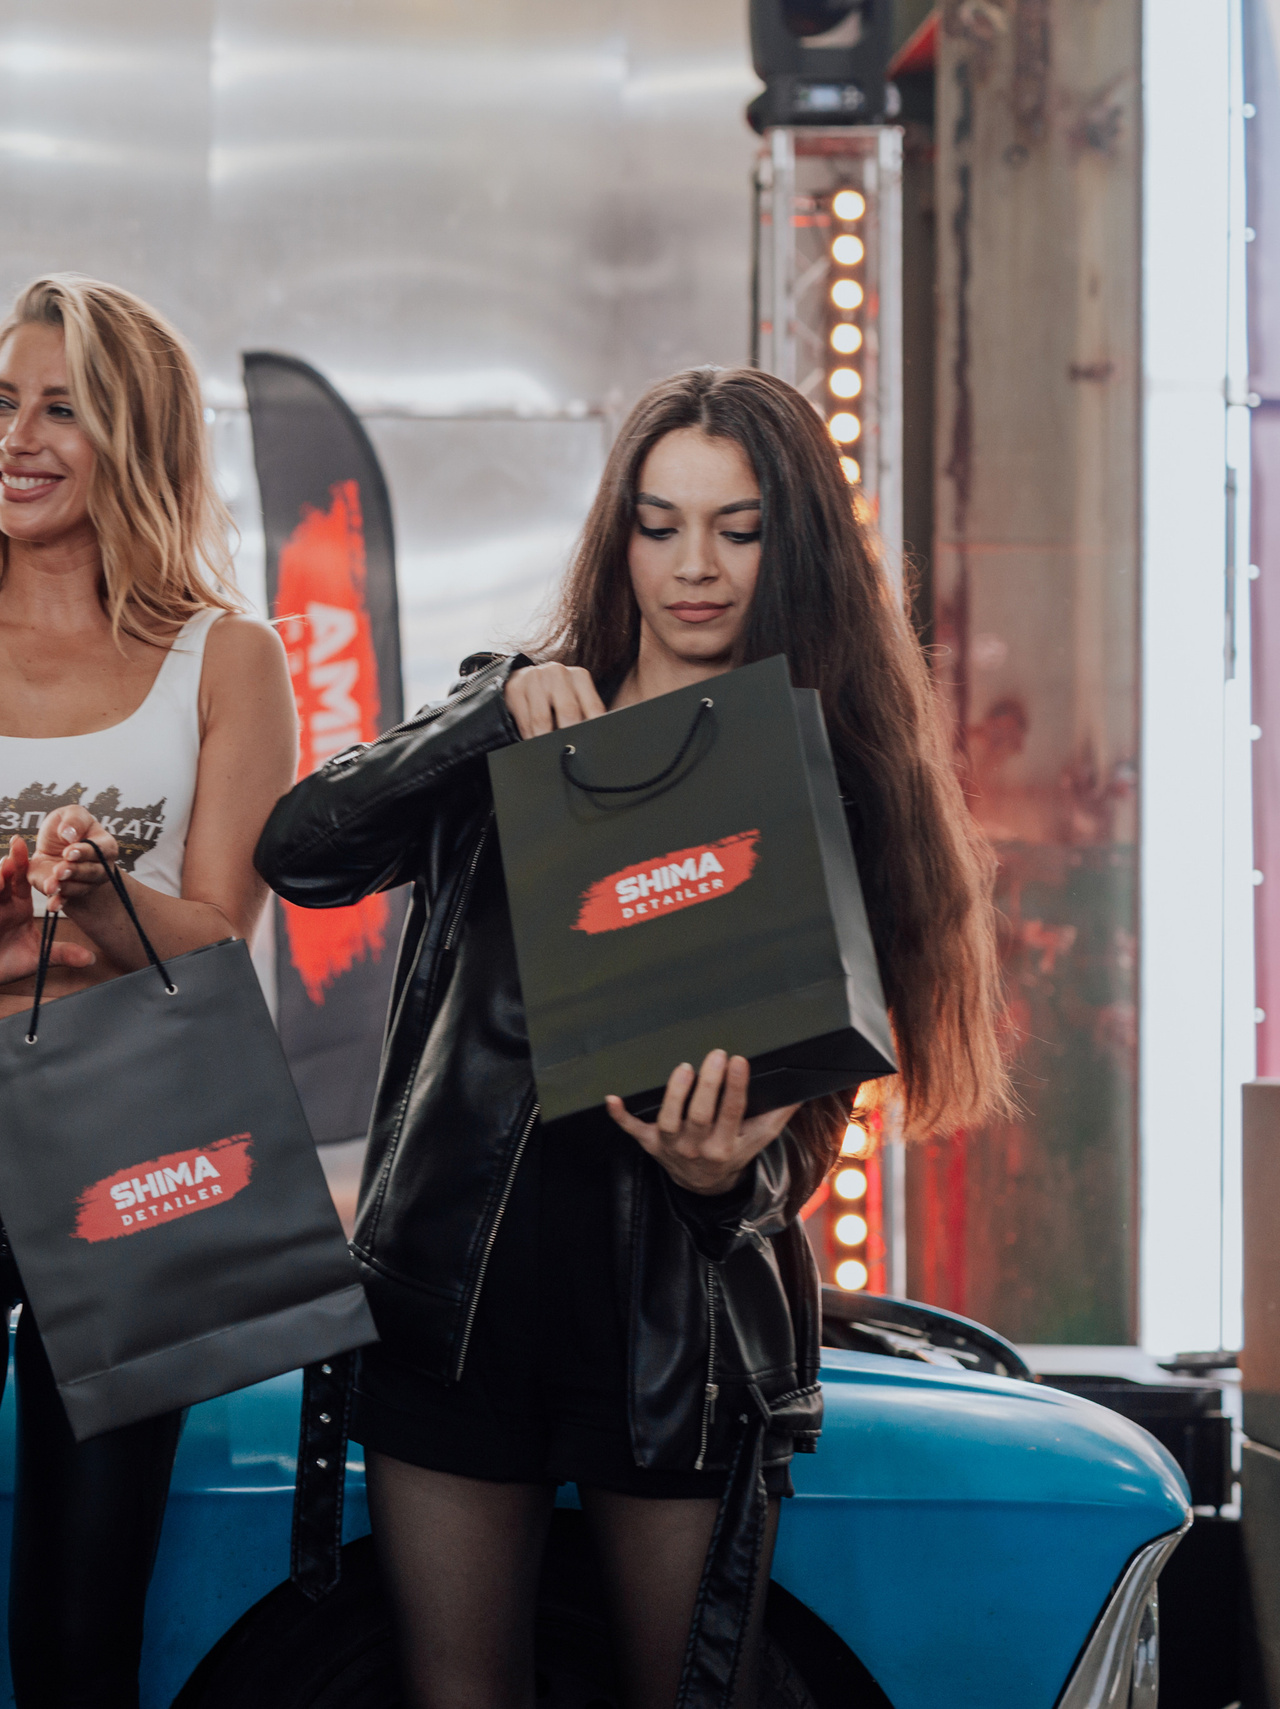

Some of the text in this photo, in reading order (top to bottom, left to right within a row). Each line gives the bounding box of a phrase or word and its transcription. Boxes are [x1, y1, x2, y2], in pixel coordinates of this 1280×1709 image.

[614, 852, 724, 904] SHIMA
[621, 879, 725, 919] DETAILER
[109, 1155, 221, 1210] SHIMA
[120, 1184, 223, 1226] DETAILER
